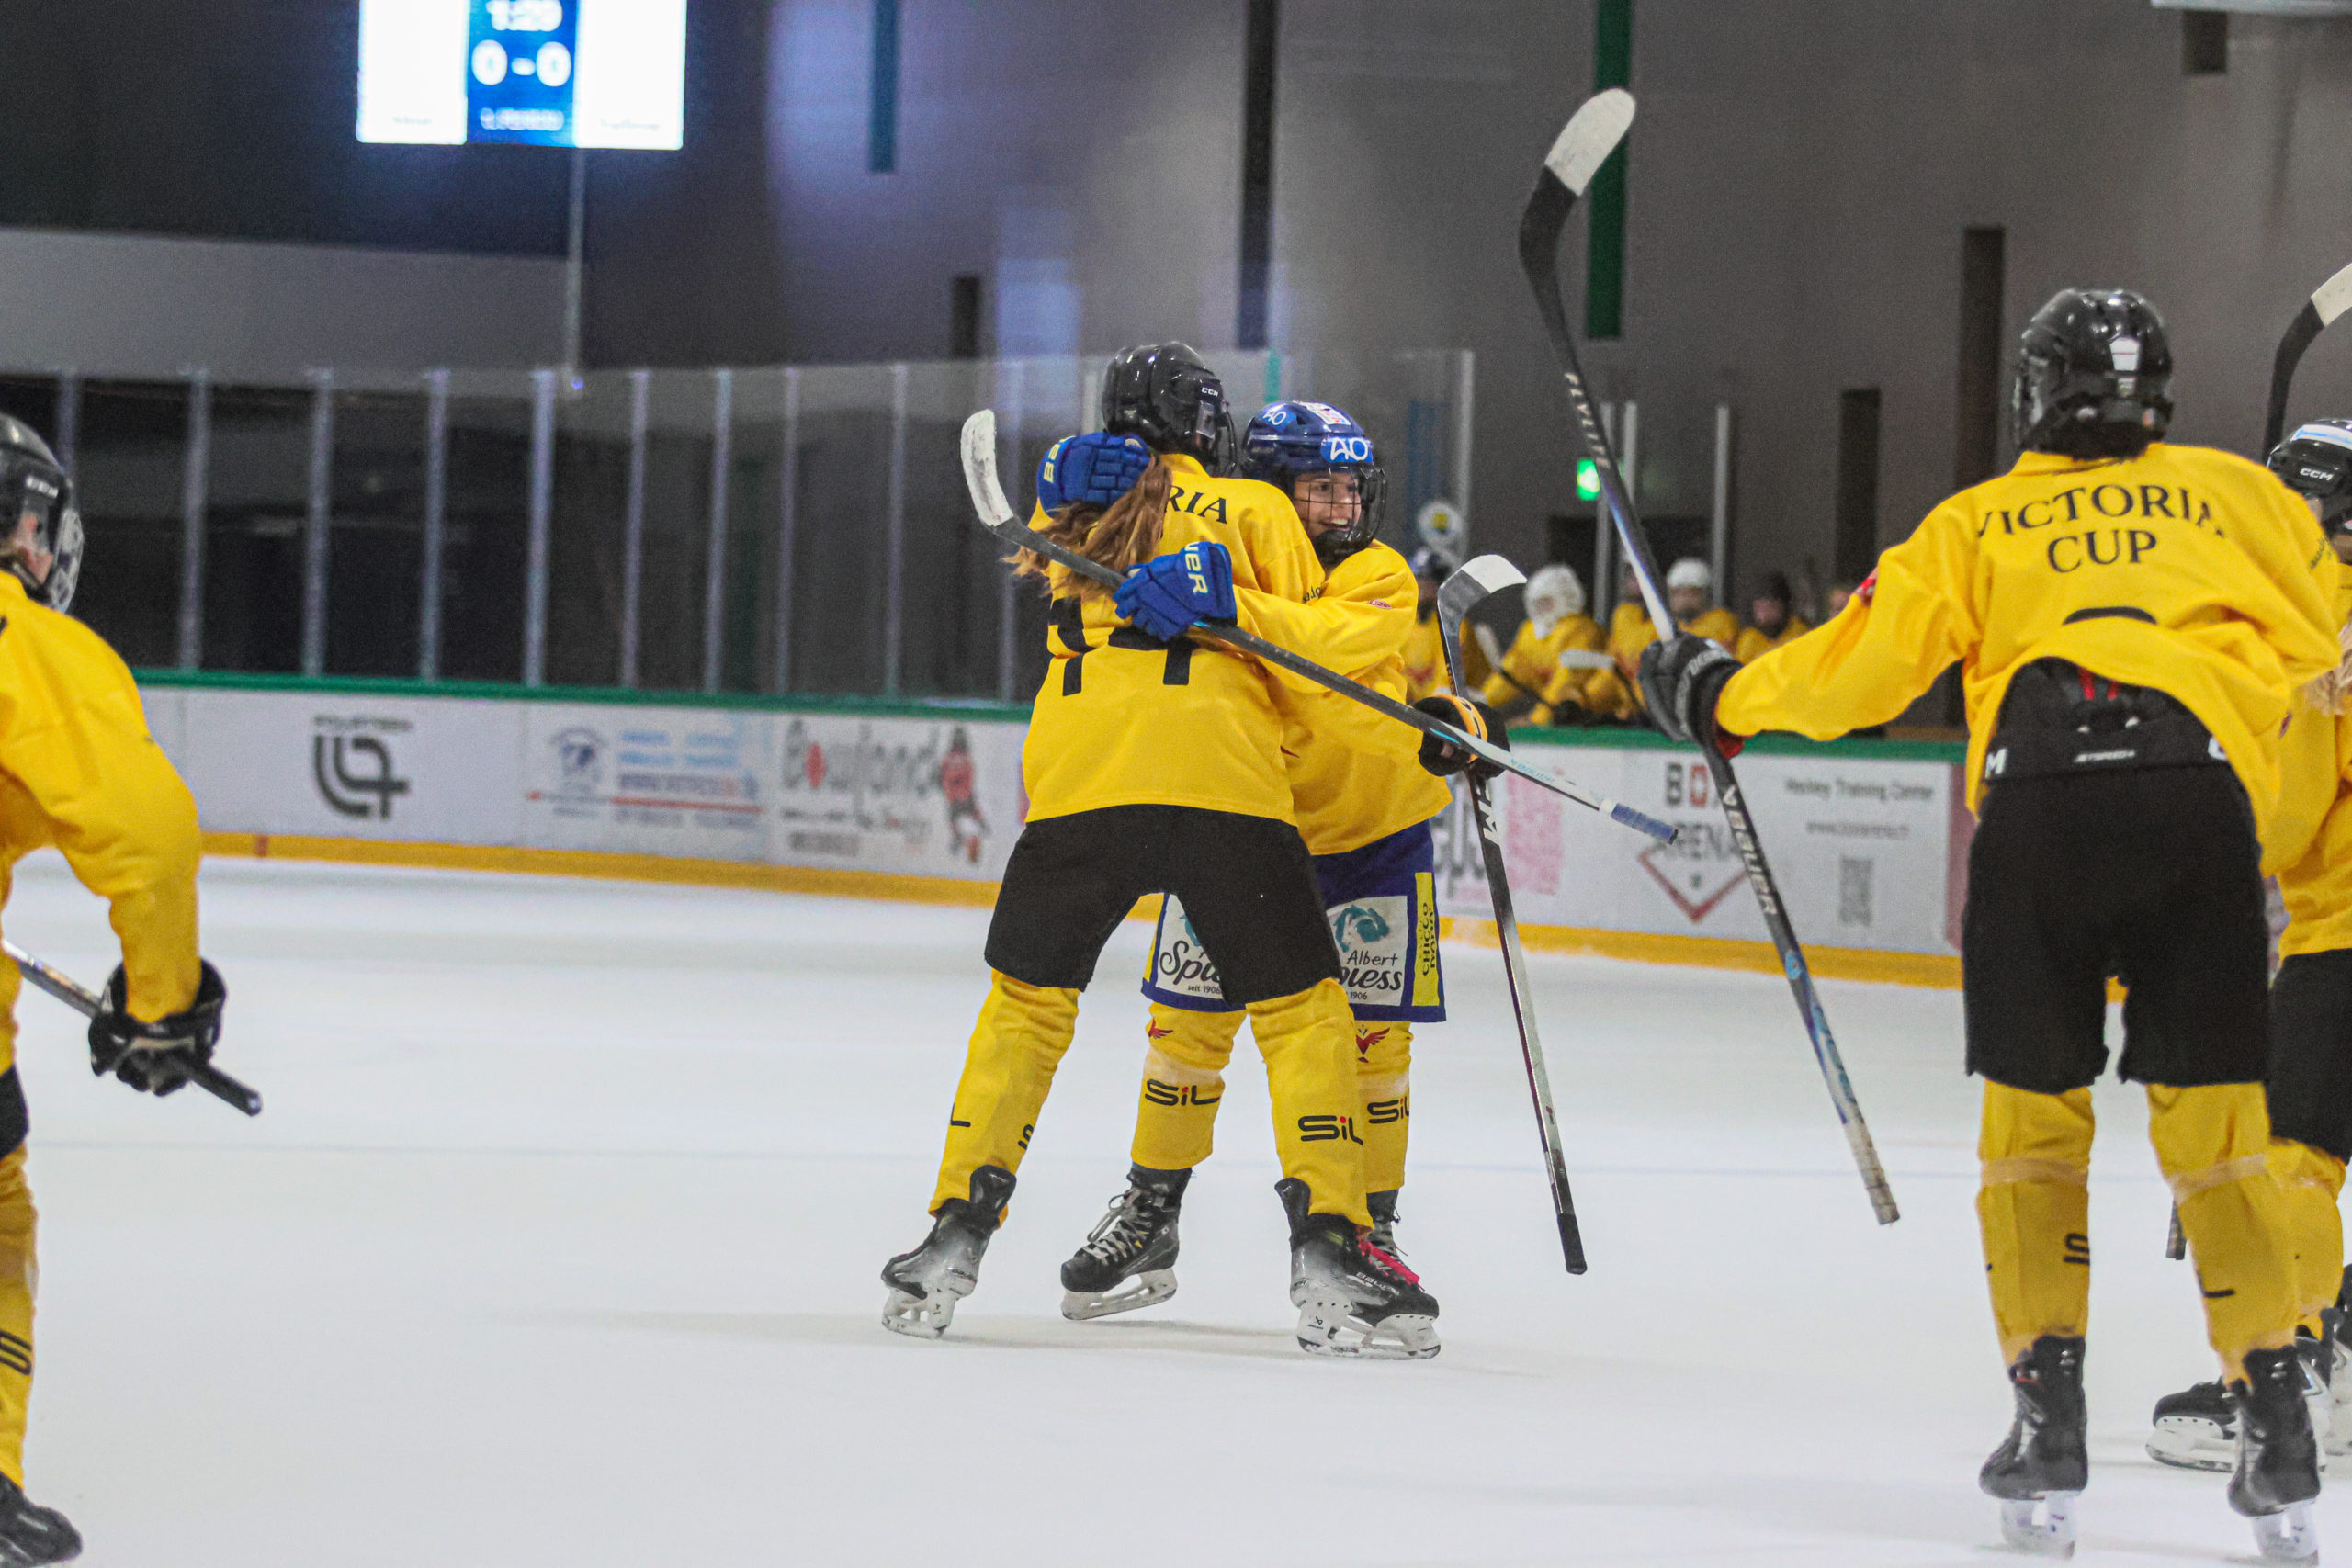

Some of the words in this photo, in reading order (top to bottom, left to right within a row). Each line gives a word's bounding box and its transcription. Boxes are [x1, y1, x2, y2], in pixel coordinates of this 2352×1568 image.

[2300, 467, 2334, 481] CCM
[2047, 529, 2157, 573] CUP
[1184, 541, 1208, 594] UER
[1667, 761, 1720, 808] BO
[1346, 949, 1398, 966] Albert
[1340, 967, 1403, 991] iess
[1350, 991, 1368, 1000] 1906
